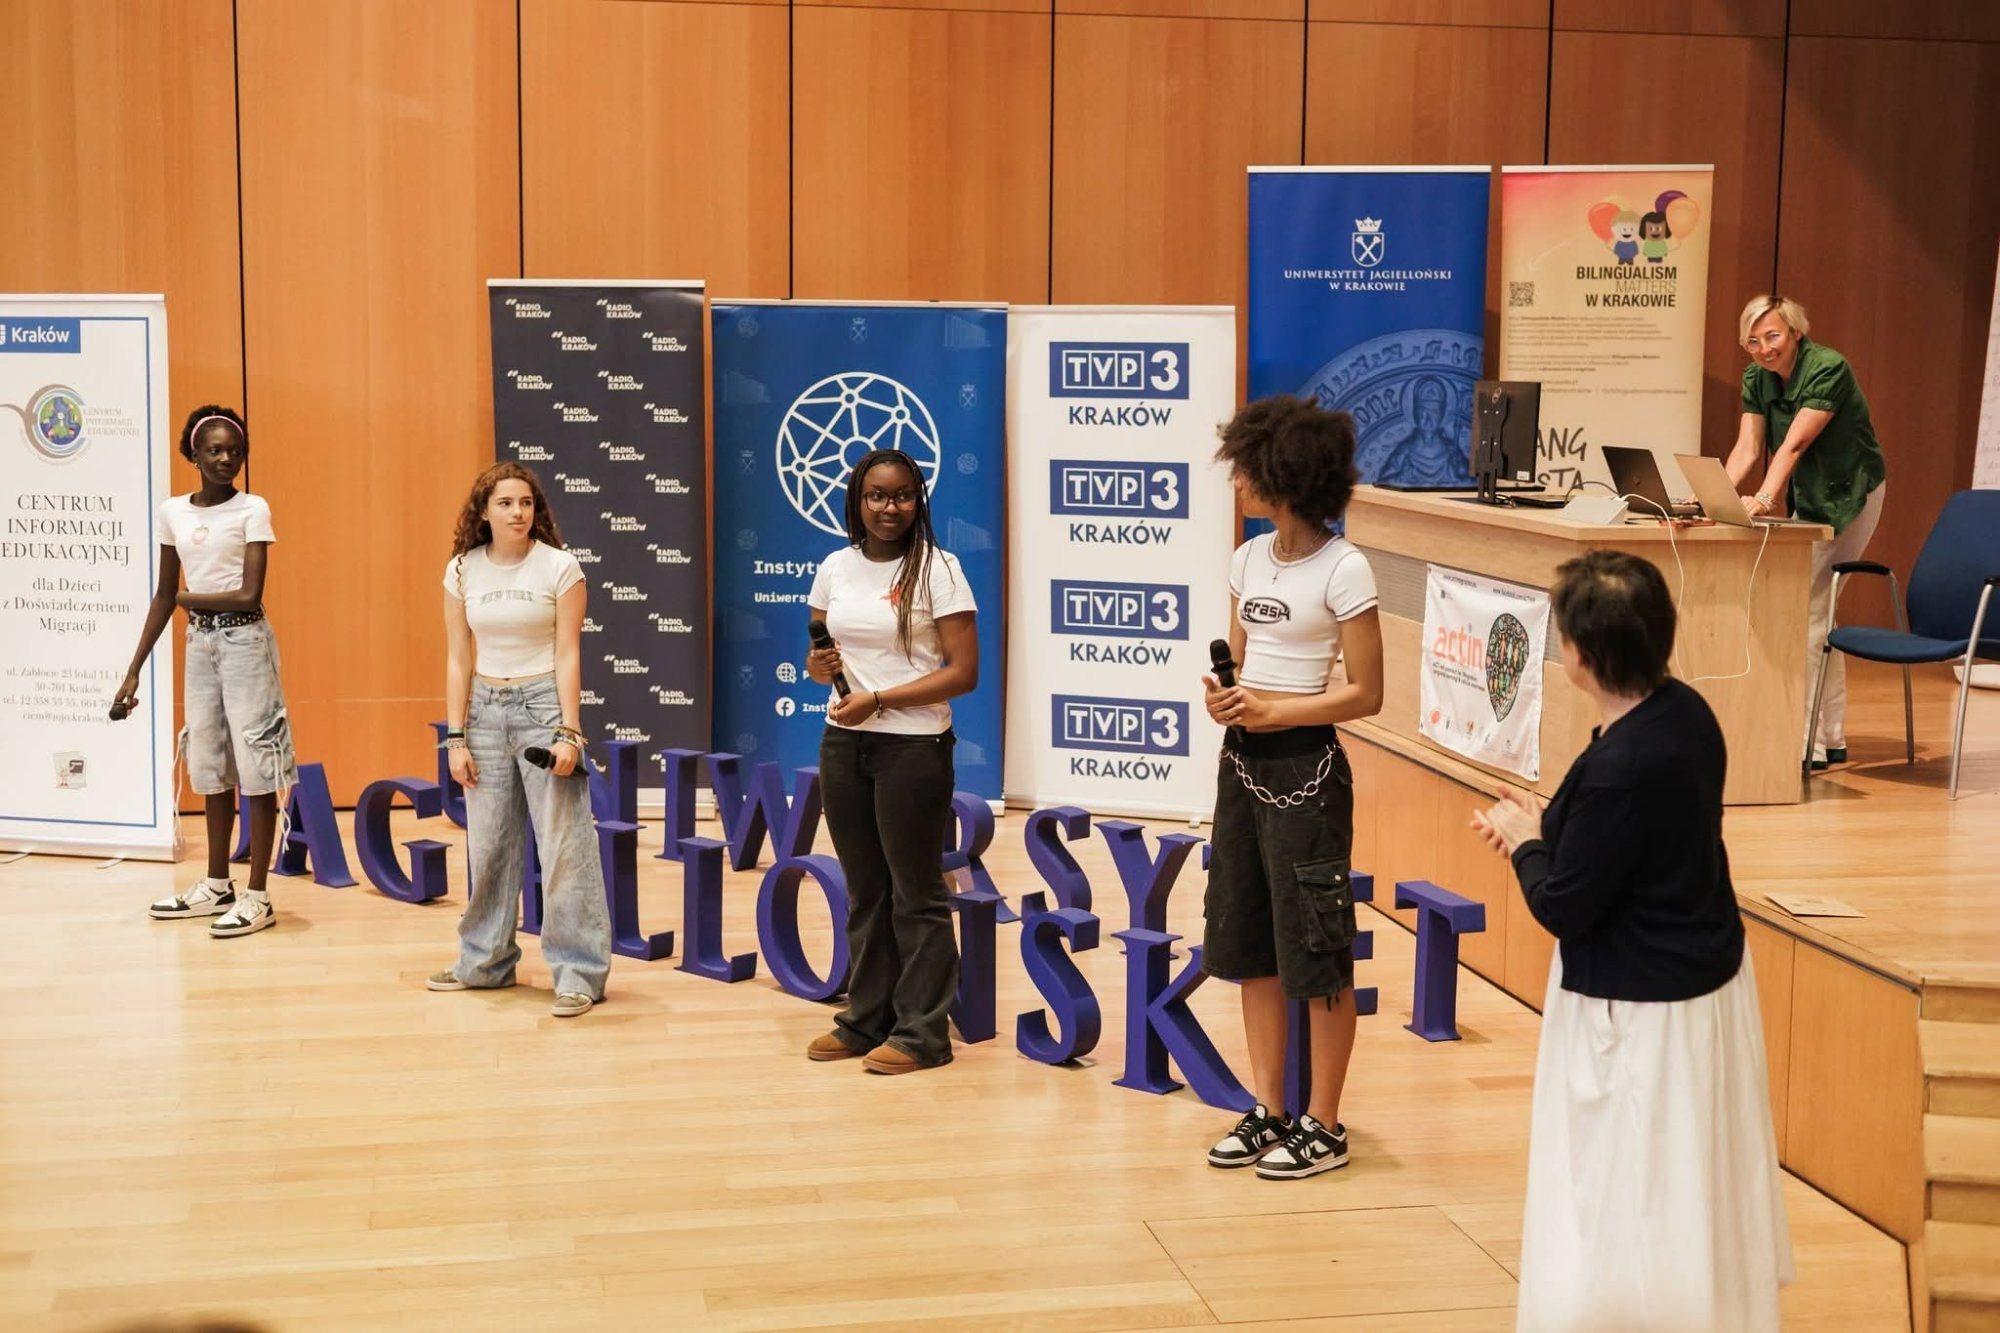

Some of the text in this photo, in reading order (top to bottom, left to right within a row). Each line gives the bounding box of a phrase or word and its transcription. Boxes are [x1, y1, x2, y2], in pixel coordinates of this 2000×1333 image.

[1284, 268, 1452, 280] UNIWERSYTET JAGIELLOŃSKI
[1576, 266, 1677, 280] BILINGUALISM
[1329, 282, 1406, 291] W KRAKOWIE
[1616, 280, 1677, 293] MATTERS
[1586, 294, 1676, 307] W KRAKOWIE
[11, 326, 70, 343] Kraków
[1069, 401, 1172, 426] KRAKÓW
[17, 493, 113, 512] CENTRUM
[8, 518, 123, 541] INFORMACJI
[1069, 520, 1172, 545] KRAKÓW
[2, 542, 130, 566] EDUKACYJNEJ
[32, 578, 102, 592] dla Dzieci
[3, 597, 130, 613] z Doświadczeniem
[39, 617, 97, 635] Migracji
[1070, 640, 1172, 666] KRAKÓW
[802, 703, 827, 712] Inst
[1070, 756, 1172, 782] KRAKÓW
